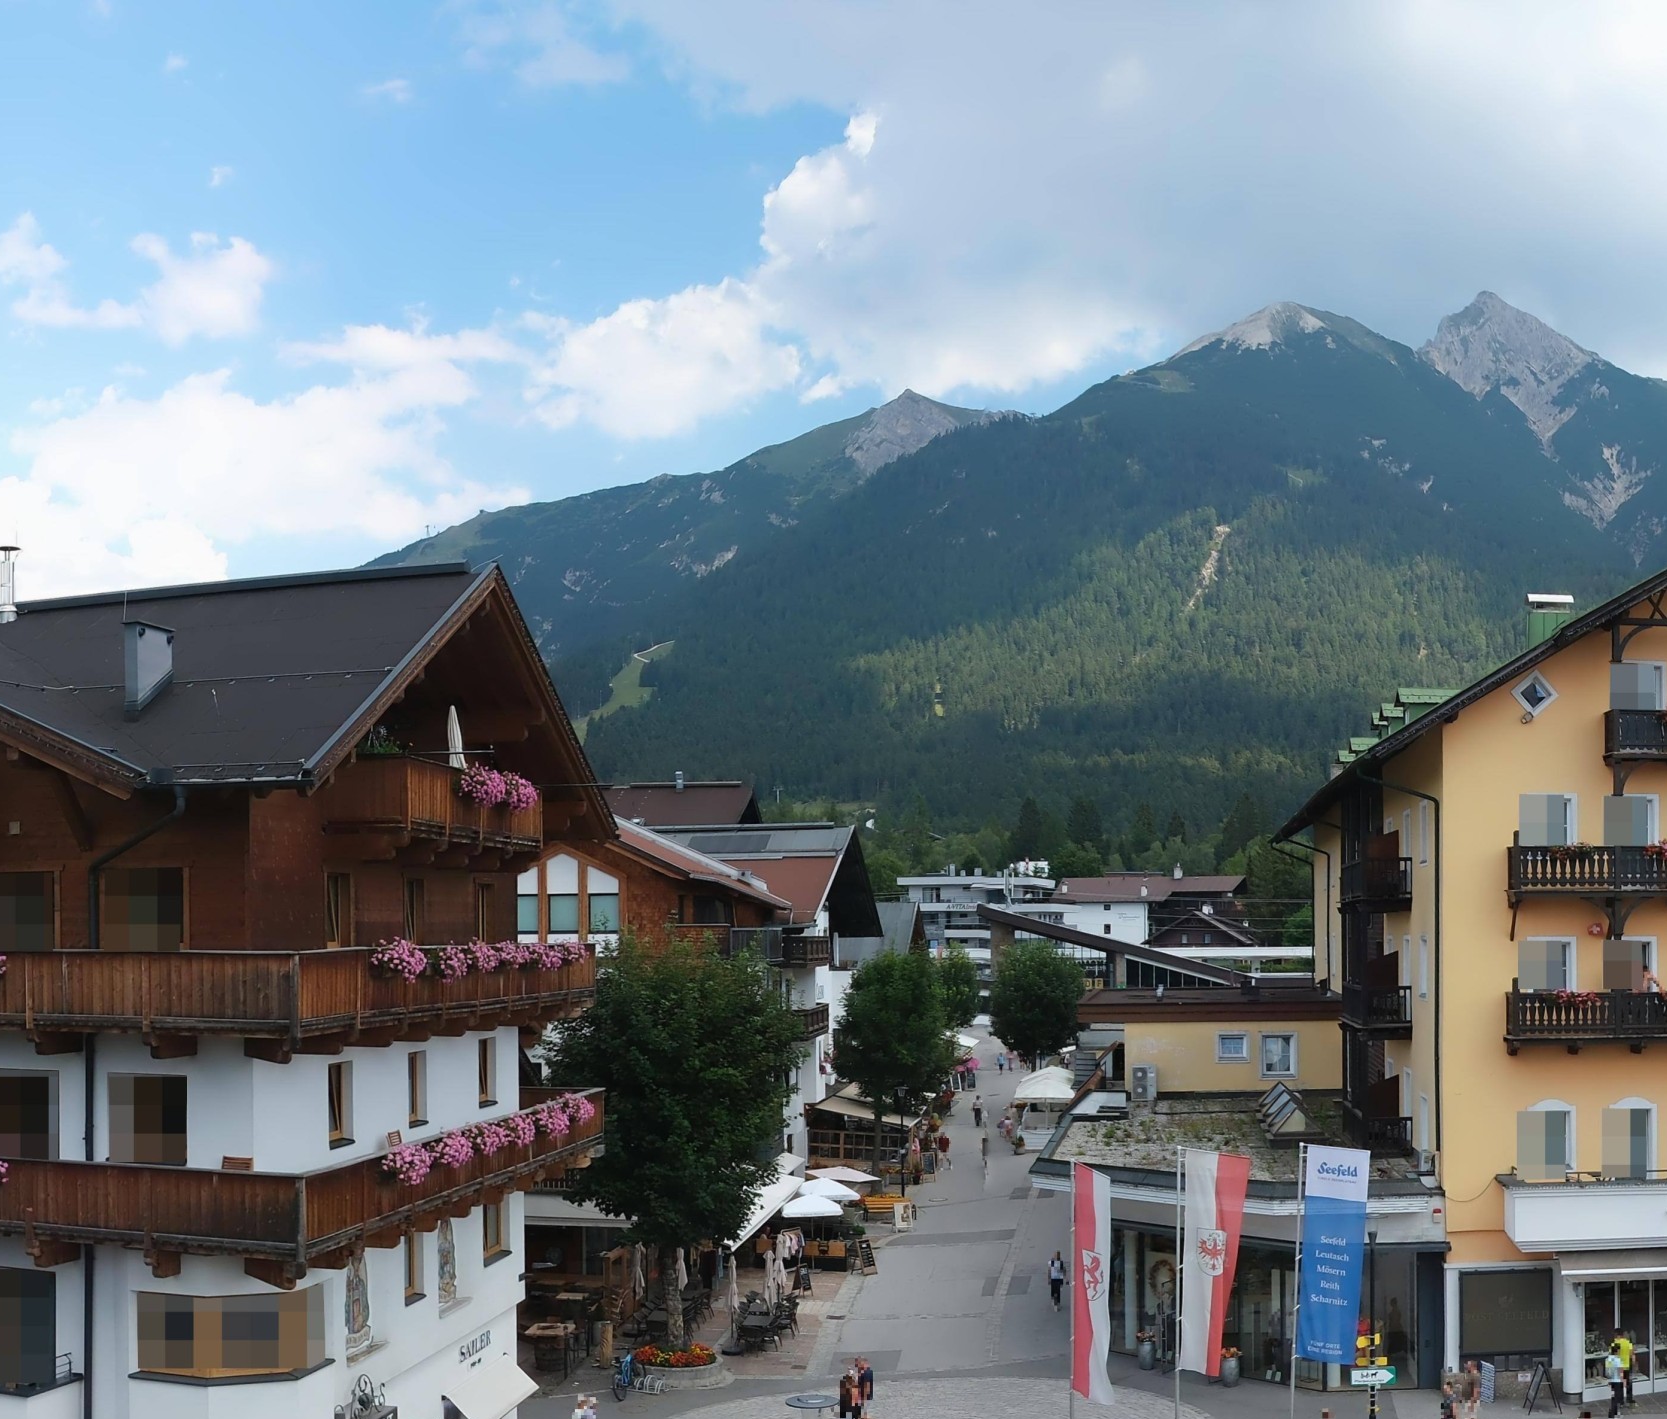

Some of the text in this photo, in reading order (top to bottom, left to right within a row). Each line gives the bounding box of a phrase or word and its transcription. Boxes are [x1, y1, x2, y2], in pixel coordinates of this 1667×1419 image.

[1317, 1161, 1358, 1177] Seefeld
[1320, 1235, 1346, 1247] Seefeld
[1315, 1250, 1349, 1262] Leutasch
[1316, 1264, 1346, 1276] Mösern
[1320, 1280, 1340, 1291] Reith
[1310, 1294, 1348, 1306] Scharnitz
[458, 1329, 492, 1364] SAILER
